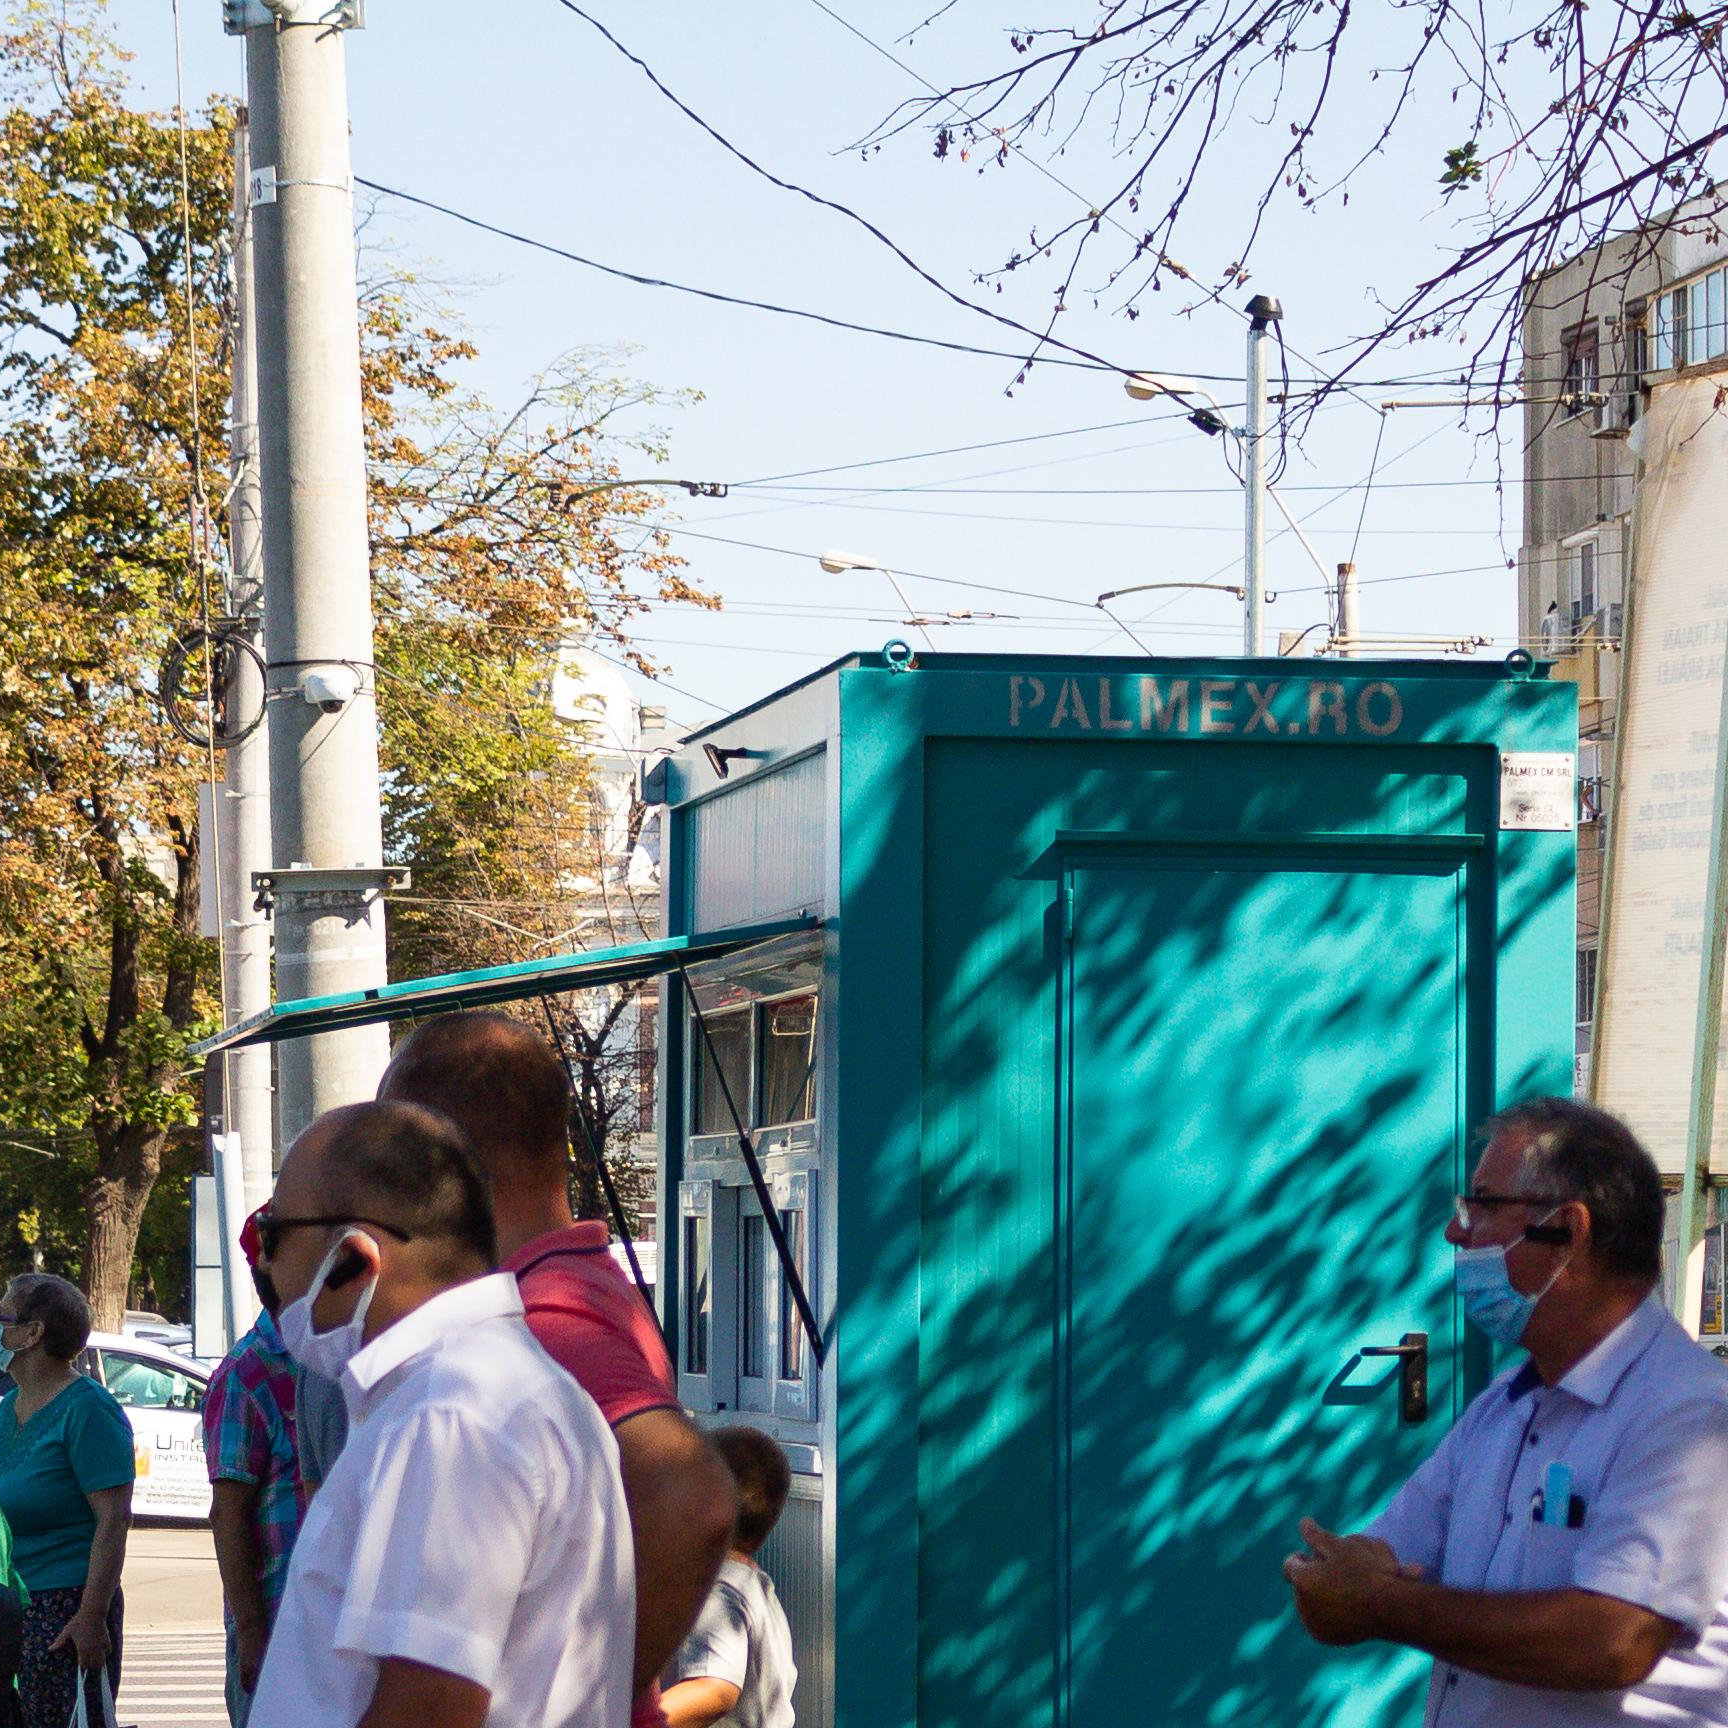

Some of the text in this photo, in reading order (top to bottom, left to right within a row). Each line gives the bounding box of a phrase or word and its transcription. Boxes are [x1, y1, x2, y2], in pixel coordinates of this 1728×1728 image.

[1008, 675, 1404, 736] PALMEX.RO
[1504, 767, 1537, 777] PALMEX
[1556, 767, 1572, 777] SRL
